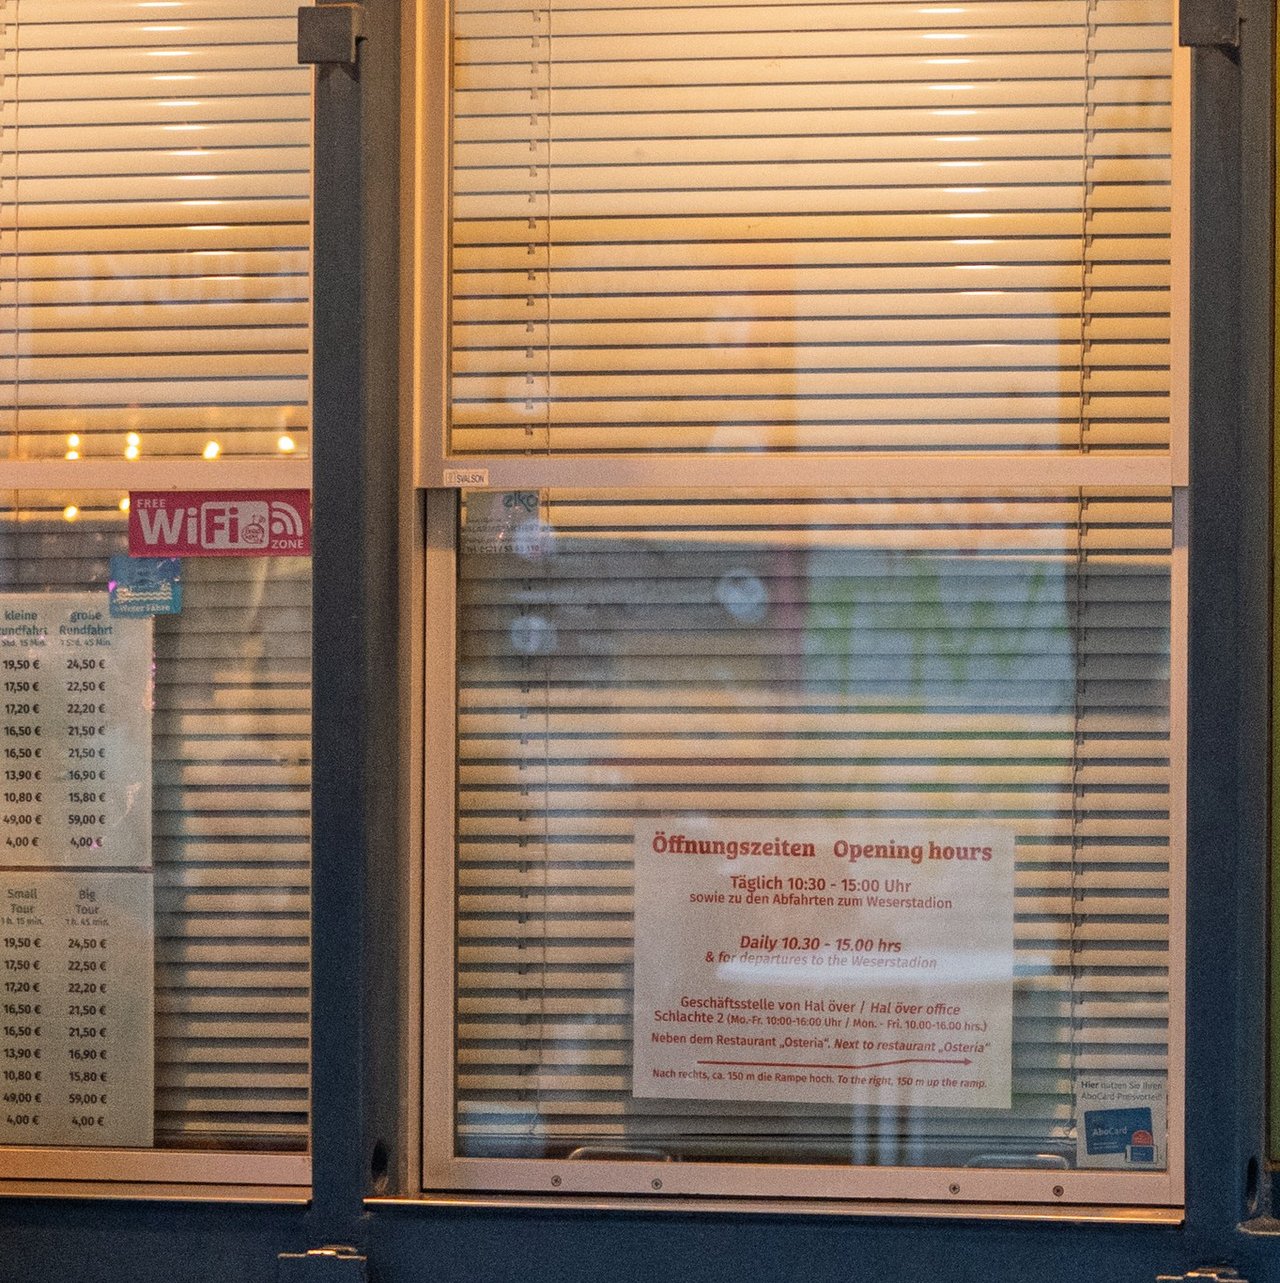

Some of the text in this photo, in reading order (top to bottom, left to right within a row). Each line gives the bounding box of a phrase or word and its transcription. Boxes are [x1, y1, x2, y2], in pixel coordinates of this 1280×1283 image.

[137, 499, 166, 508] FREE
[138, 507, 239, 545] WiFi
[272, 539, 304, 549] ZONE
[4, 609, 38, 621] kleine
[59, 624, 113, 636] Rundfahrt
[2, 659, 30, 671] 19,50
[67, 659, 96, 671] 24,50
[5, 681, 30, 692] 17,50
[67, 681, 96, 692] 22,50
[5, 703, 30, 715] 17,20
[67, 703, 96, 715] 22,20
[4, 726, 32, 737] 16,50
[68, 726, 95, 737] 21,50
[4, 748, 32, 759] 16,50
[68, 748, 95, 759] 21,50
[4, 770, 32, 781] 13,90
[68, 770, 96, 781] 16,90
[3, 792, 33, 803] 10,80
[68, 792, 96, 803] 15,80
[3, 814, 34, 826] 49,00
[68, 814, 96, 826] 59,00
[5, 837, 30, 848] 4,00
[70, 837, 93, 848] 4,00
[652, 831, 992, 864] Öffnungszeiten Opening hours
[730, 875, 911, 893] Täglich 10:30 15:00 Uhr
[7, 888, 38, 899] Small
[78, 888, 97, 902] Big
[689, 891, 952, 909] sowie zu den Abfahrten zum Weserstadion
[10, 903, 35, 914] Tour
[75, 904, 100, 915] Tour
[3, 937, 32, 949] 19,50
[68, 938, 97, 950] 24,50
[740, 935, 902, 952] Daily 10.30 15.00 hrs
[4, 960, 30, 971] 17,50
[705, 951, 937, 968] & for departures to the Weserstadion
[68, 960, 97, 972] 22,50
[4, 982, 30, 993] 17,20
[68, 983, 97, 994] 22,20
[3, 1004, 32, 1016] 16,50
[68, 1004, 96, 1016] 21,50
[681, 996, 961, 1015] Geschäftsstelle von Hal över Hal över office
[654, 1010, 987, 1032] Schlachte 2 (Mo.-Fr. 10:00-16:00 Uhr Mon. Fri. 10.00-16.00 hrs.)
[3, 1026, 32, 1038] 16,50
[68, 1026, 96, 1038] 21,50
[651, 1032, 686, 1044] Neben
[689, 1033, 713, 1044] dem
[716, 1035, 776, 1047] Restaurant
[834, 1038, 860, 1050] Next
[862, 1040, 874, 1050] to
[876, 1041, 936, 1052] restaurant
[3, 1048, 32, 1060] 13,90
[69, 1049, 96, 1060] 16,90
[3, 1070, 32, 1082] 10,80
[69, 1071, 97, 1083] 15,80
[652, 1069, 676, 1079] Nach
[678, 1070, 710, 1081] rechts,
[712, 1072, 725, 1080] ca.
[728, 1071, 744, 1081] 150
[758, 1072, 773, 1082] die
[774, 1072, 807, 1084] Rampe
[809, 1073, 835, 1084] hoch.
[838, 1075, 848, 1084] To
[850, 1075, 866, 1085] the
[897, 1077, 913, 1086] 150
[927, 1079, 939, 1088] up
[941, 1078, 958, 1087] the
[959, 1080, 987, 1090] ramp.
[3, 1092, 32, 1104] 49,00
[69, 1093, 98, 1105] 59,00
[6, 1115, 30, 1126] 4,00
[71, 1116, 95, 1127] 4,00
